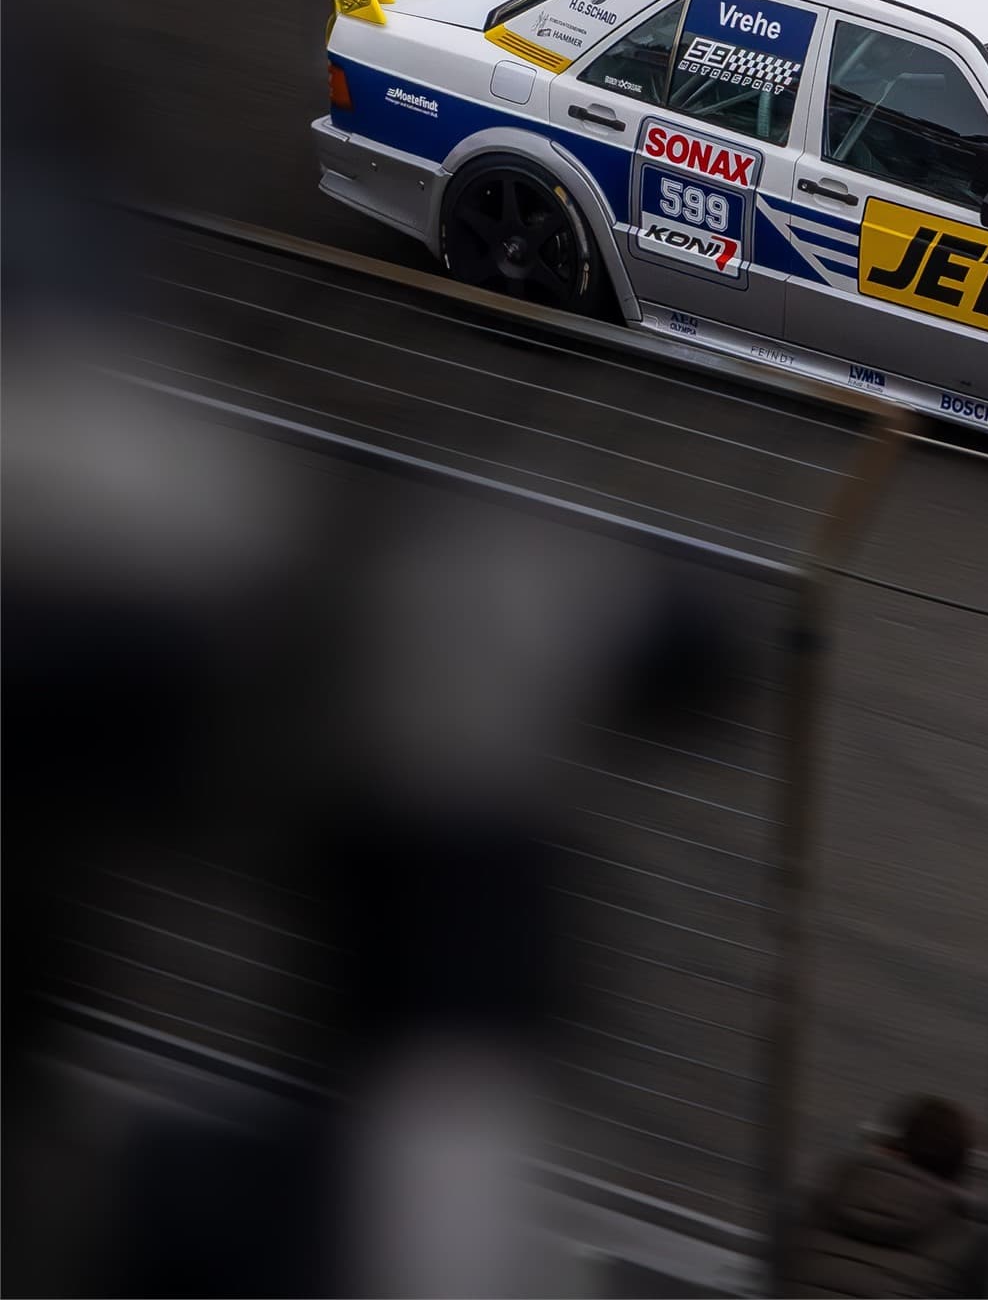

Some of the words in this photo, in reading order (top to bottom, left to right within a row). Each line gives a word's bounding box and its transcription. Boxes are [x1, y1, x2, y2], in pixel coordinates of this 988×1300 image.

[719, 1, 781, 40] Vrehe
[552, 30, 583, 48] HAMMER
[677, 60, 785, 95] MOTORSPORT
[645, 127, 754, 187] SONAX
[659, 177, 730, 233] 599
[644, 224, 724, 261] KONI
[670, 311, 699, 329] AEG
[670, 322, 697, 336] OLYMPIA
[751, 345, 795, 365] FEINDT
